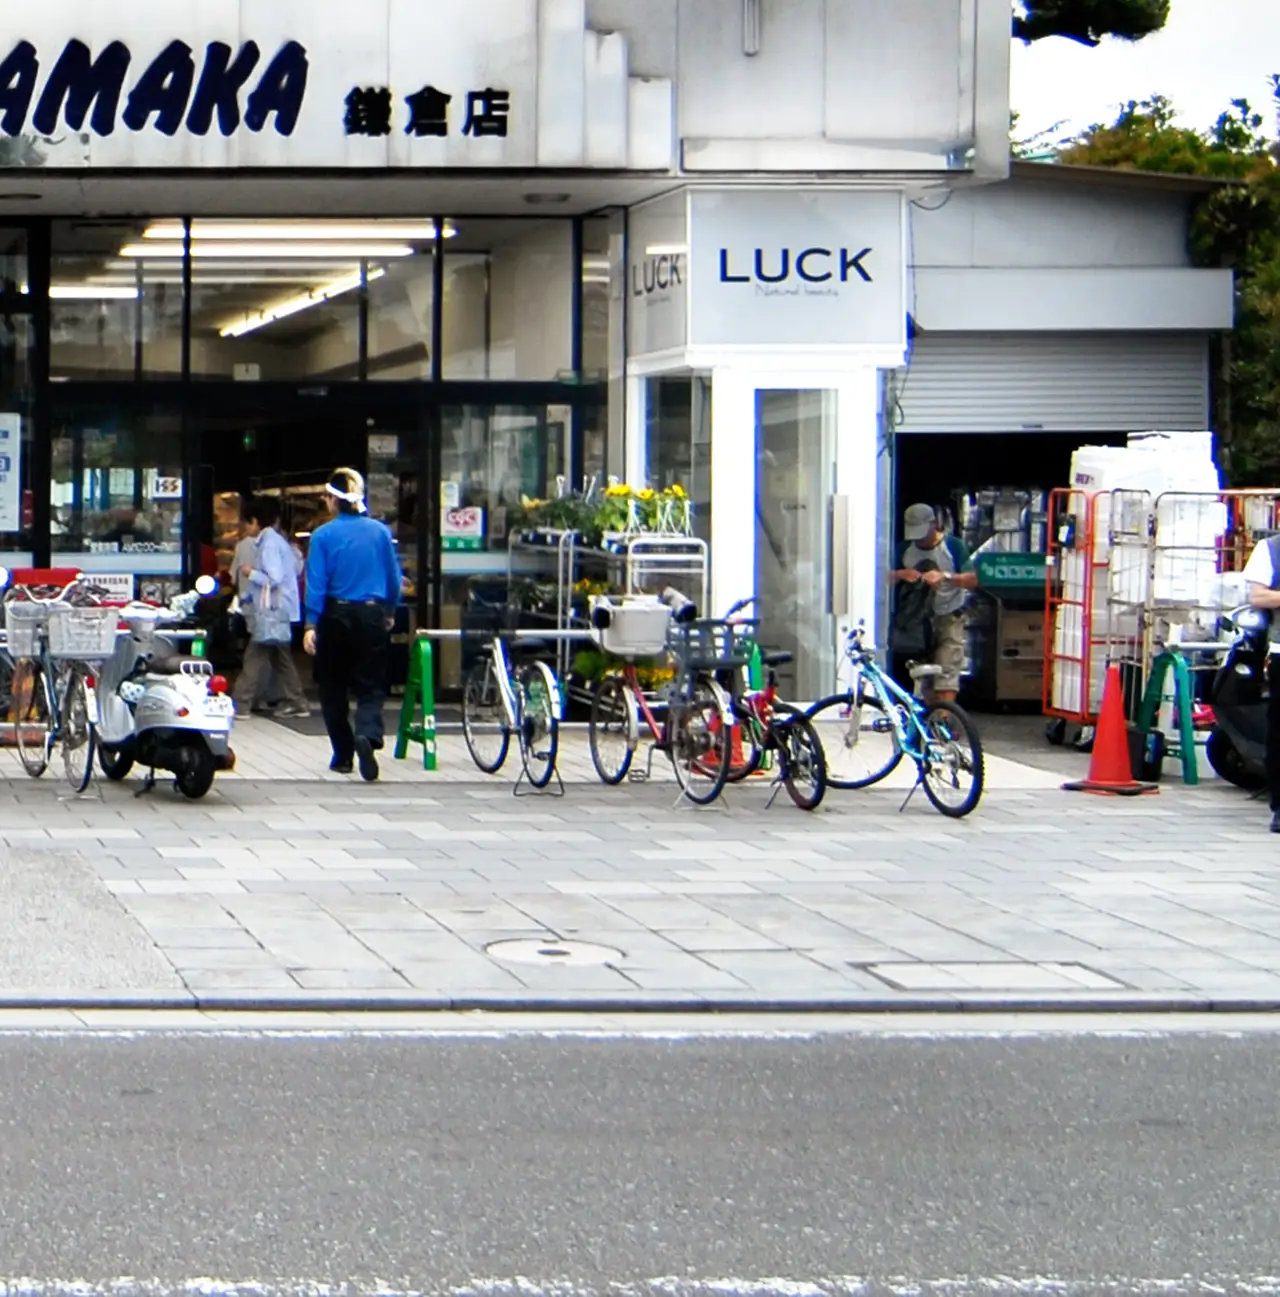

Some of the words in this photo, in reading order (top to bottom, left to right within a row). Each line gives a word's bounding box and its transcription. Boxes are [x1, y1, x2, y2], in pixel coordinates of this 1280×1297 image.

[343, 85, 510, 138] 鎌倉店
[633, 254, 682, 297] LUCK
[720, 247, 873, 282] LUCK
